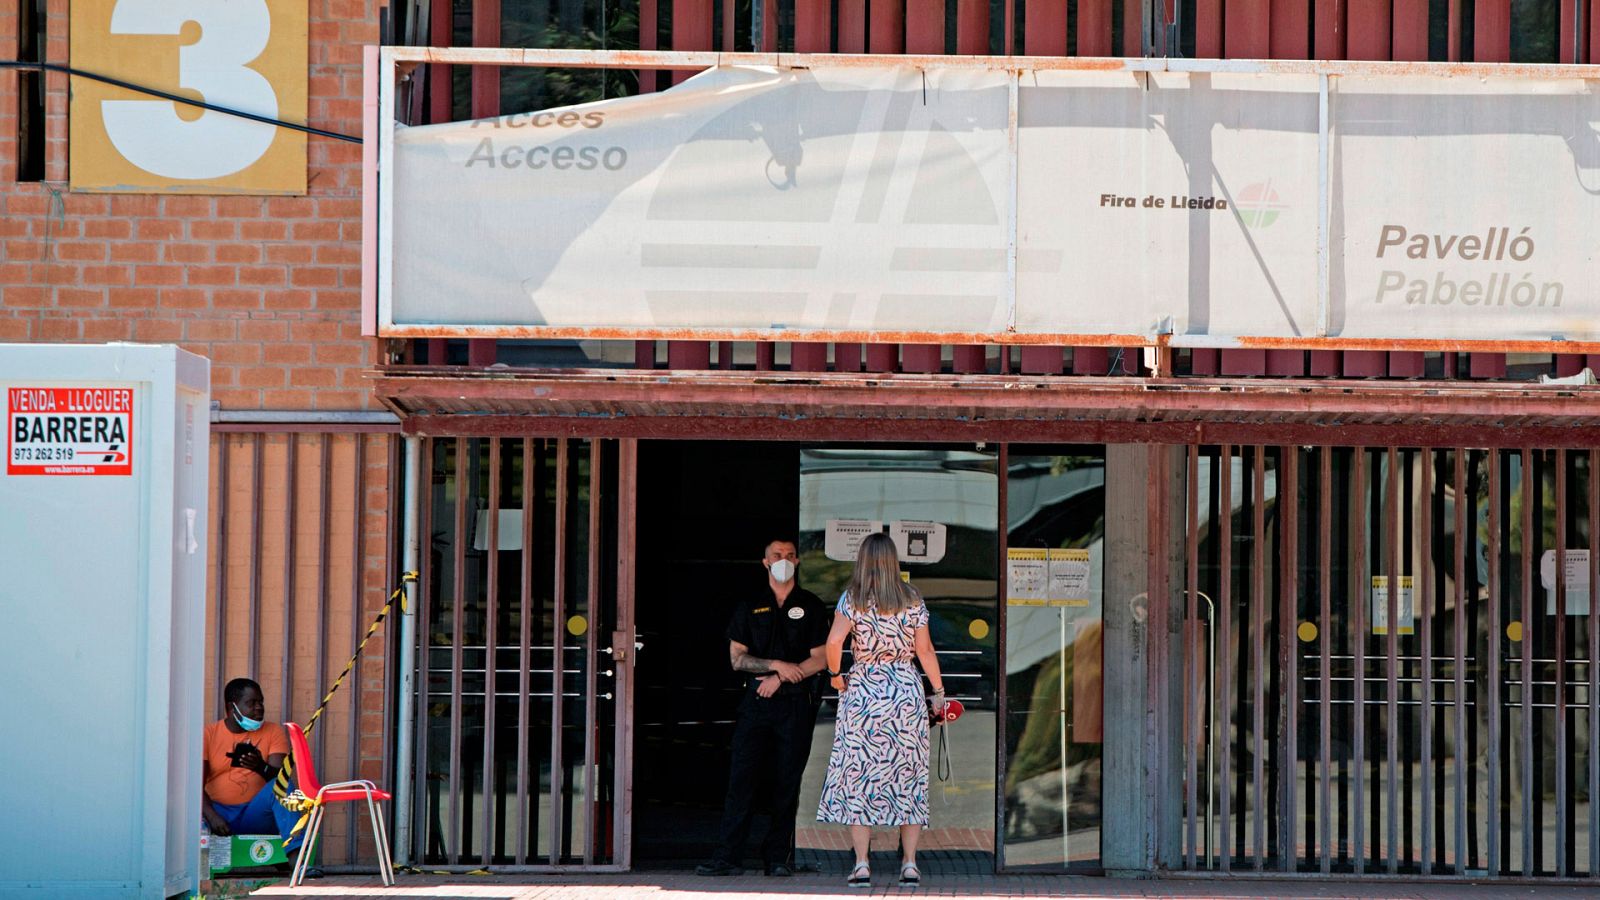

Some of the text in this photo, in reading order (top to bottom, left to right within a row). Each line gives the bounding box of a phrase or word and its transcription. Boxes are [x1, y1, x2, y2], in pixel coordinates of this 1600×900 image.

[101, 0, 278, 180] 3
[465, 136, 628, 171] Acceso
[1100, 194, 1228, 210] Fira de Lleida
[1376, 224, 1535, 261] Pavelló
[1375, 270, 1564, 307] Pabellón
[11, 389, 56, 411] VENDA
[68, 390, 130, 411] LLOGUER
[15, 416, 126, 443] BARRERA
[14, 448, 74, 460] 973 262 519
